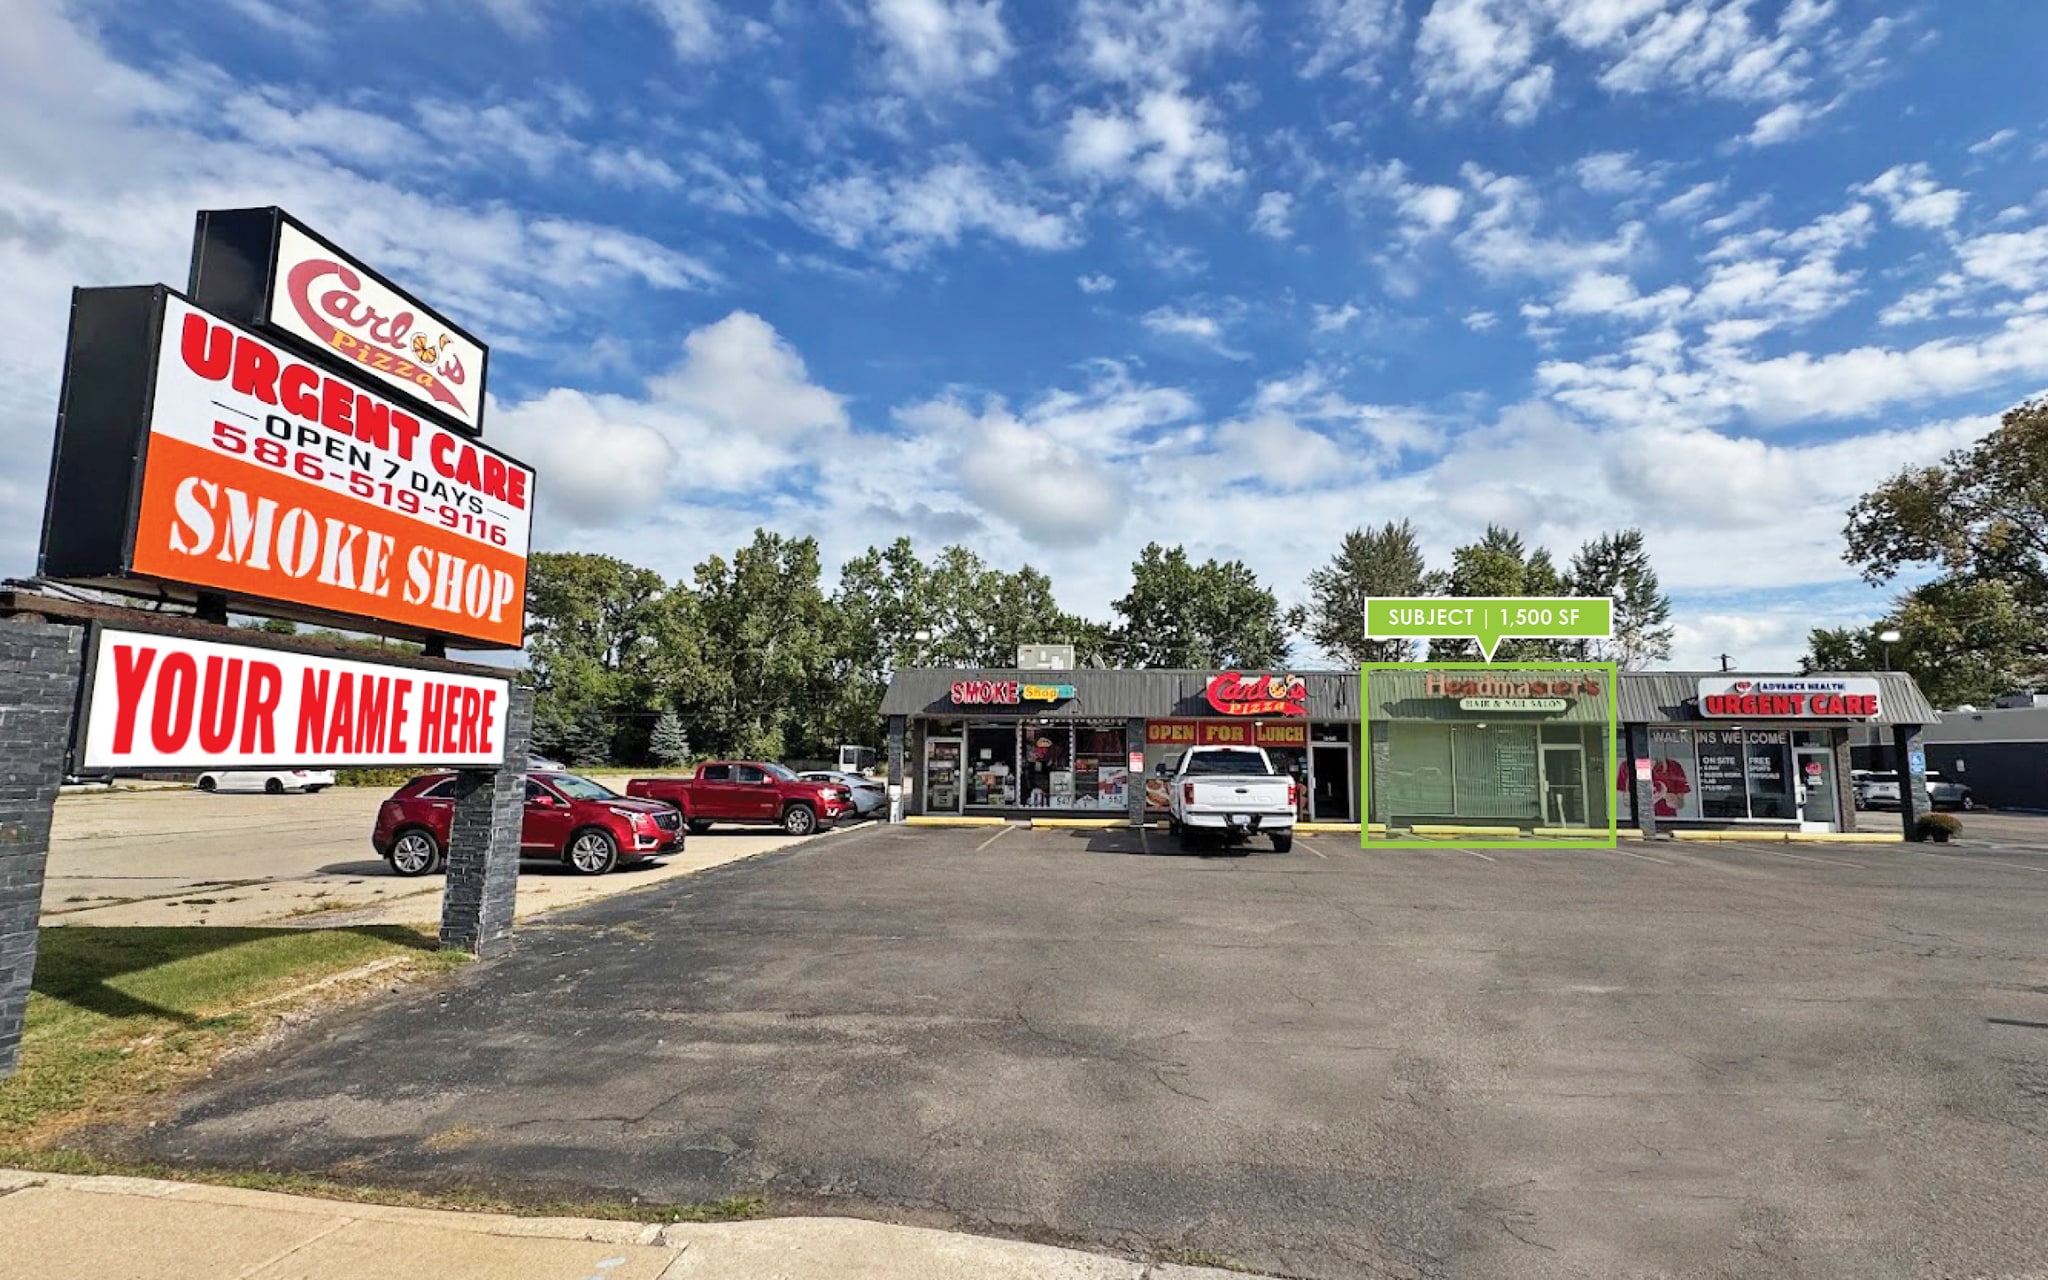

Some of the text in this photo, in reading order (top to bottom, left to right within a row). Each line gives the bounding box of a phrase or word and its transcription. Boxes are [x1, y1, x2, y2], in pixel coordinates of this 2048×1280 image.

[288, 259, 465, 392] Carlo's
[329, 328, 434, 388] Pizza
[181, 312, 526, 510] URGENT CARE
[266, 415, 484, 516] OPEN 7 DAYS
[212, 420, 508, 547] 586-519-9116
[168, 476, 515, 624] SMOKE SHOP
[112, 644, 496, 755] YOUR NAME HERE
[951, 681, 1058, 704] SMOKE Shop
[1207, 672, 1307, 709] Carlo's
[1426, 673, 1600, 697] Headmaster's
[1762, 682, 1844, 691] ADVANCE HEALTH
[1230, 701, 1285, 714] Pizza
[1466, 700, 1490, 708] HAIR
[1505, 700, 1527, 708] NAIL
[1532, 700, 1561, 708] SALON
[1706, 694, 1878, 714] URGENT CARE
[1150, 724, 1304, 741] OPEN FOR LUNCH
[1721, 732, 1787, 745] WELCOME
